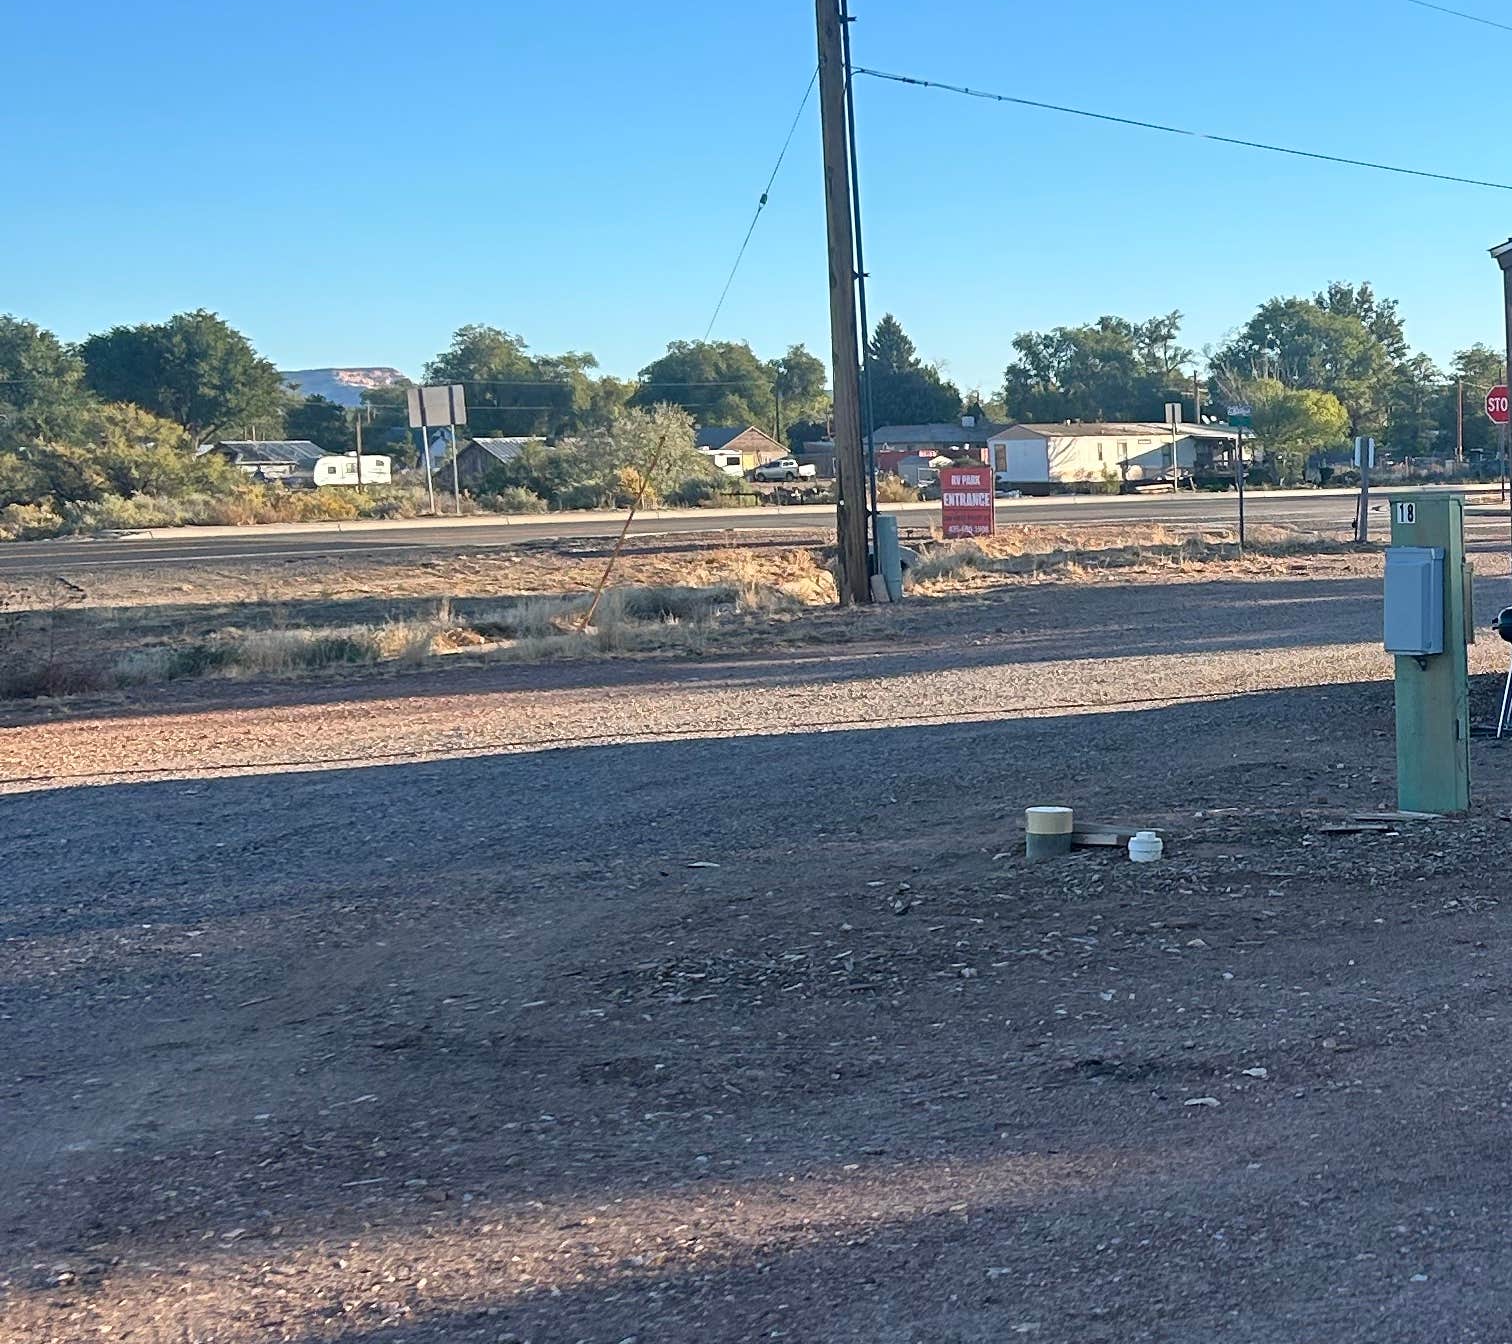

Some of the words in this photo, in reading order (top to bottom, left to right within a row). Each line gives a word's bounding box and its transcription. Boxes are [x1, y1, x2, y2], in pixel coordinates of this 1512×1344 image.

[1487, 397, 1509, 412] STO
[951, 474, 961, 486] RV
[961, 474, 980, 486] PARK
[943, 492, 991, 507] ENTRANCE
[1399, 503, 1414, 522] 18
